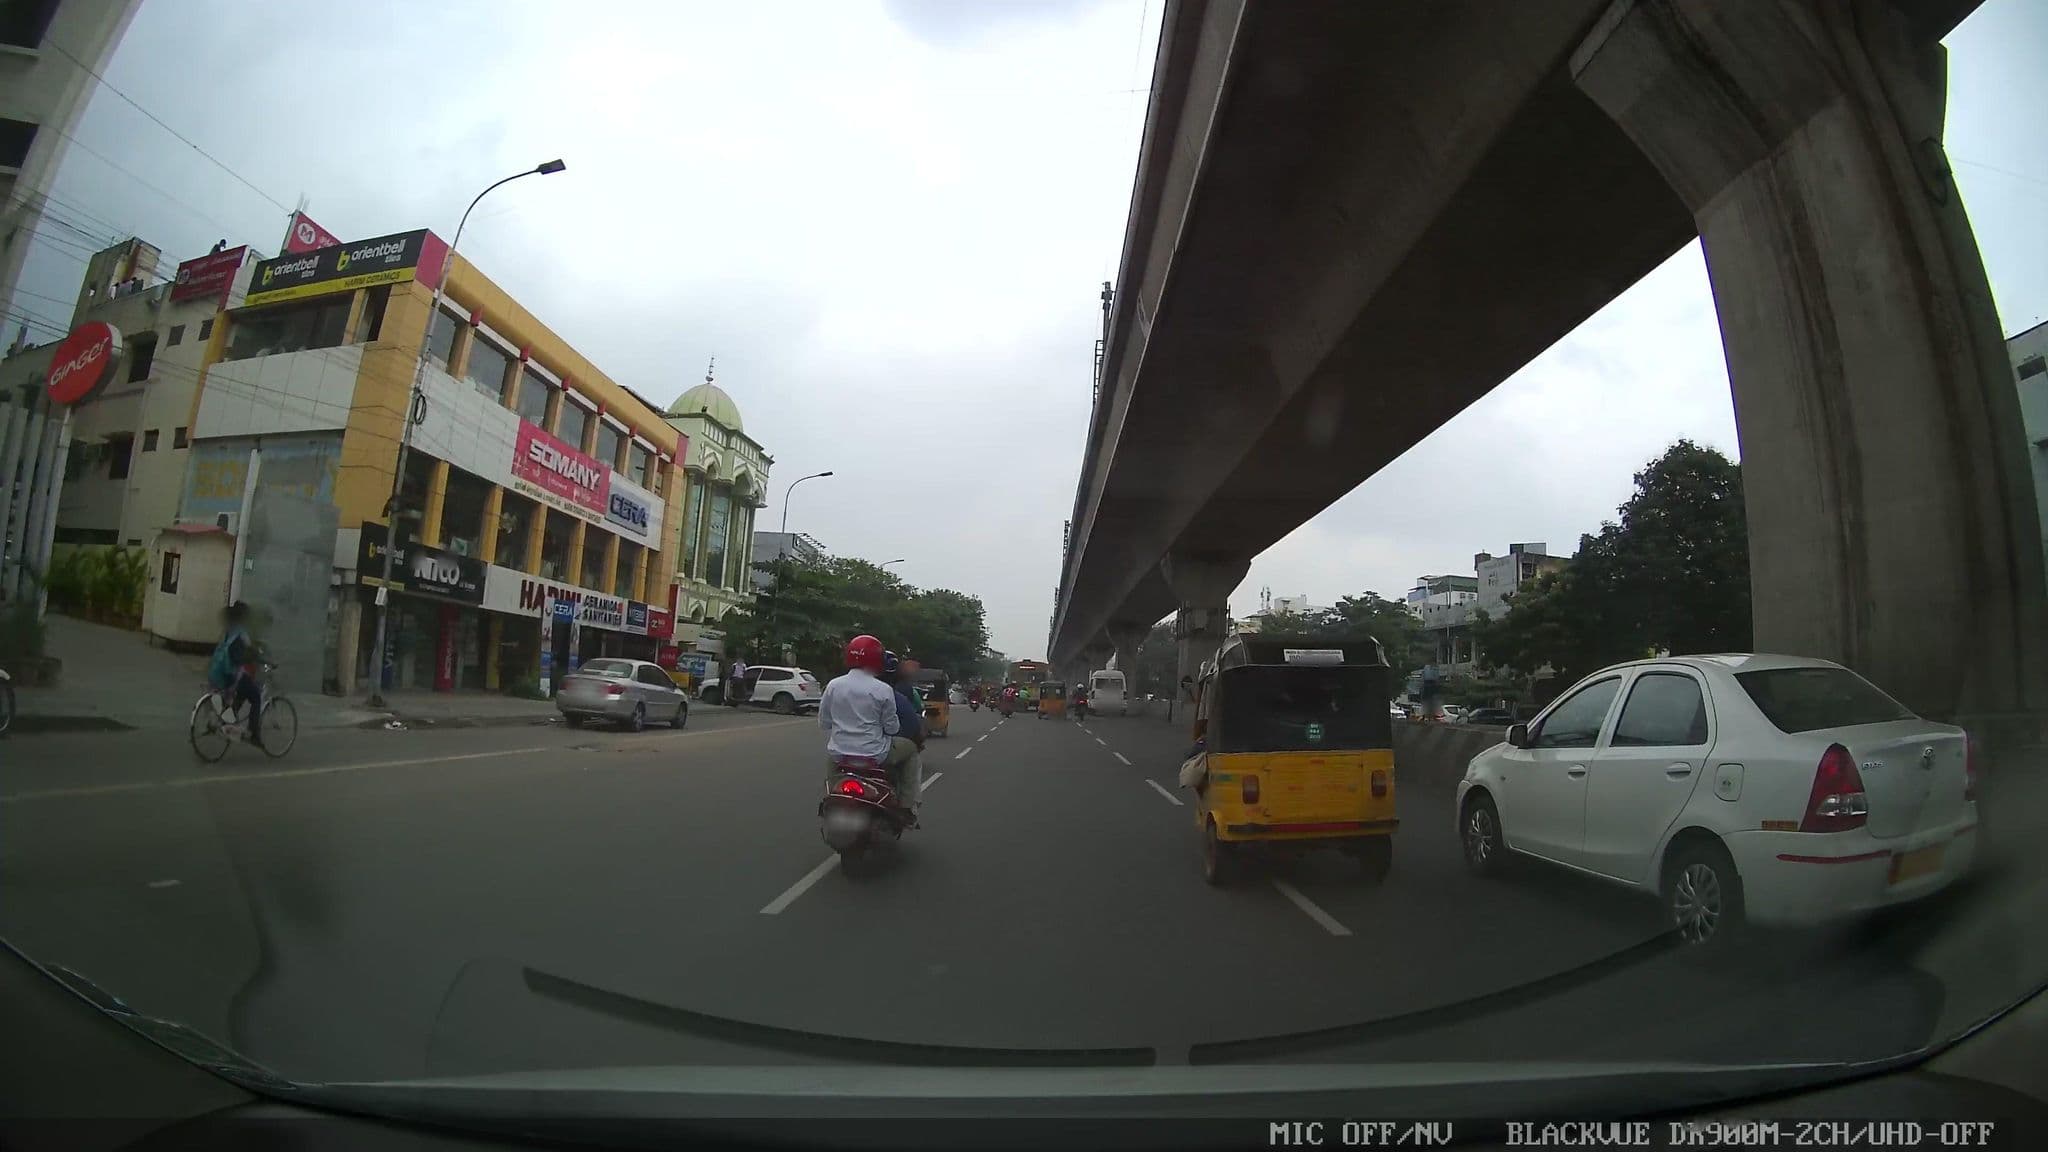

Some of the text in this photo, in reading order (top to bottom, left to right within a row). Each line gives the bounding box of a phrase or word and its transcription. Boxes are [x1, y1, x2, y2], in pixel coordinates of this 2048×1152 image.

[351, 239, 407, 261] orientbell
[274, 255, 320, 276] orientbell
[528, 438, 600, 491] SOMANY
[610, 493, 648, 529] CERA
[555, 604, 575, 617] CERA
